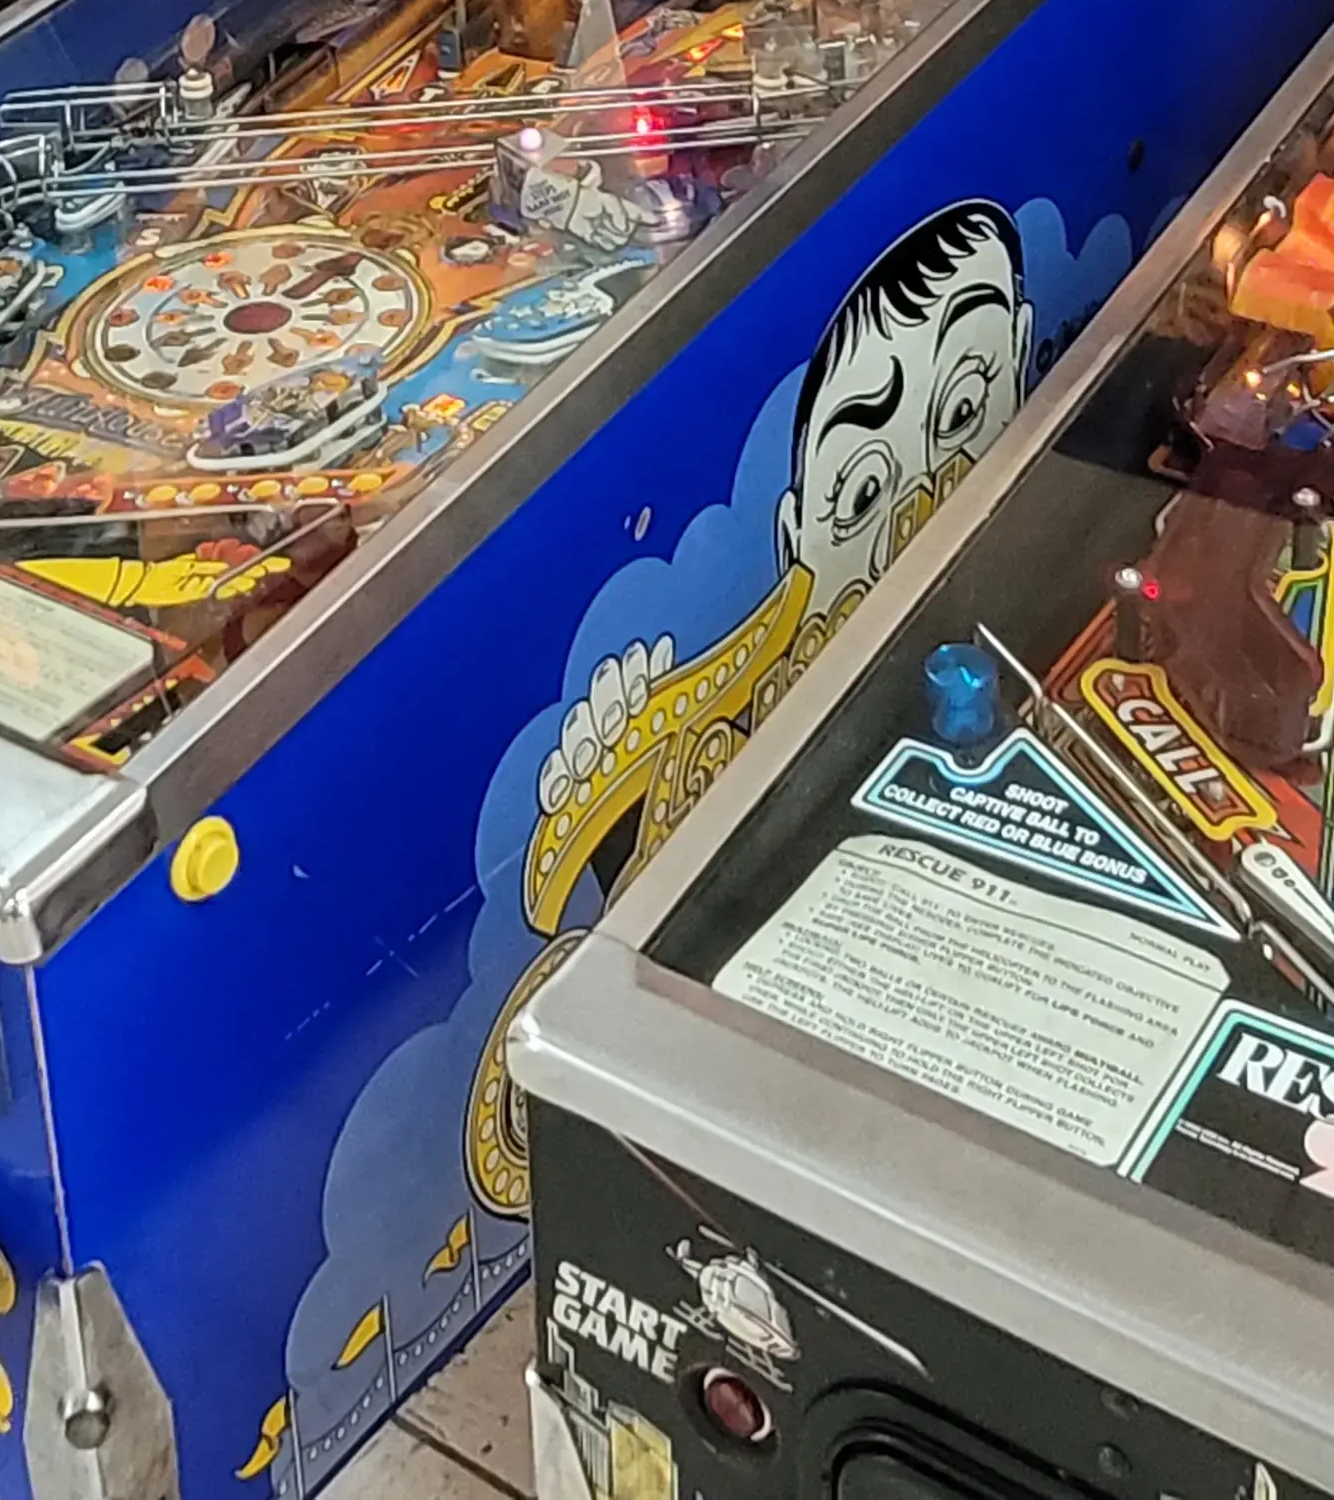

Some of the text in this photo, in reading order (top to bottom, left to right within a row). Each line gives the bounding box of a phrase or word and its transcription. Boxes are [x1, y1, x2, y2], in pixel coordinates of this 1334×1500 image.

[1115, 696, 1221, 796] CALL
[883, 783, 1148, 885] COLLECT RED OR BLUE BONUS
[949, 786, 1100, 847] CAPTIVE BALL TO
[1004, 783, 1069, 815] SHOOT
[877, 843, 969, 884] RESCUE
[971, 876, 1011, 903] 911
[1181, 955, 1212, 971] PLAY
[552, 1293, 681, 1384] GAME
[554, 1260, 687, 1352] START
